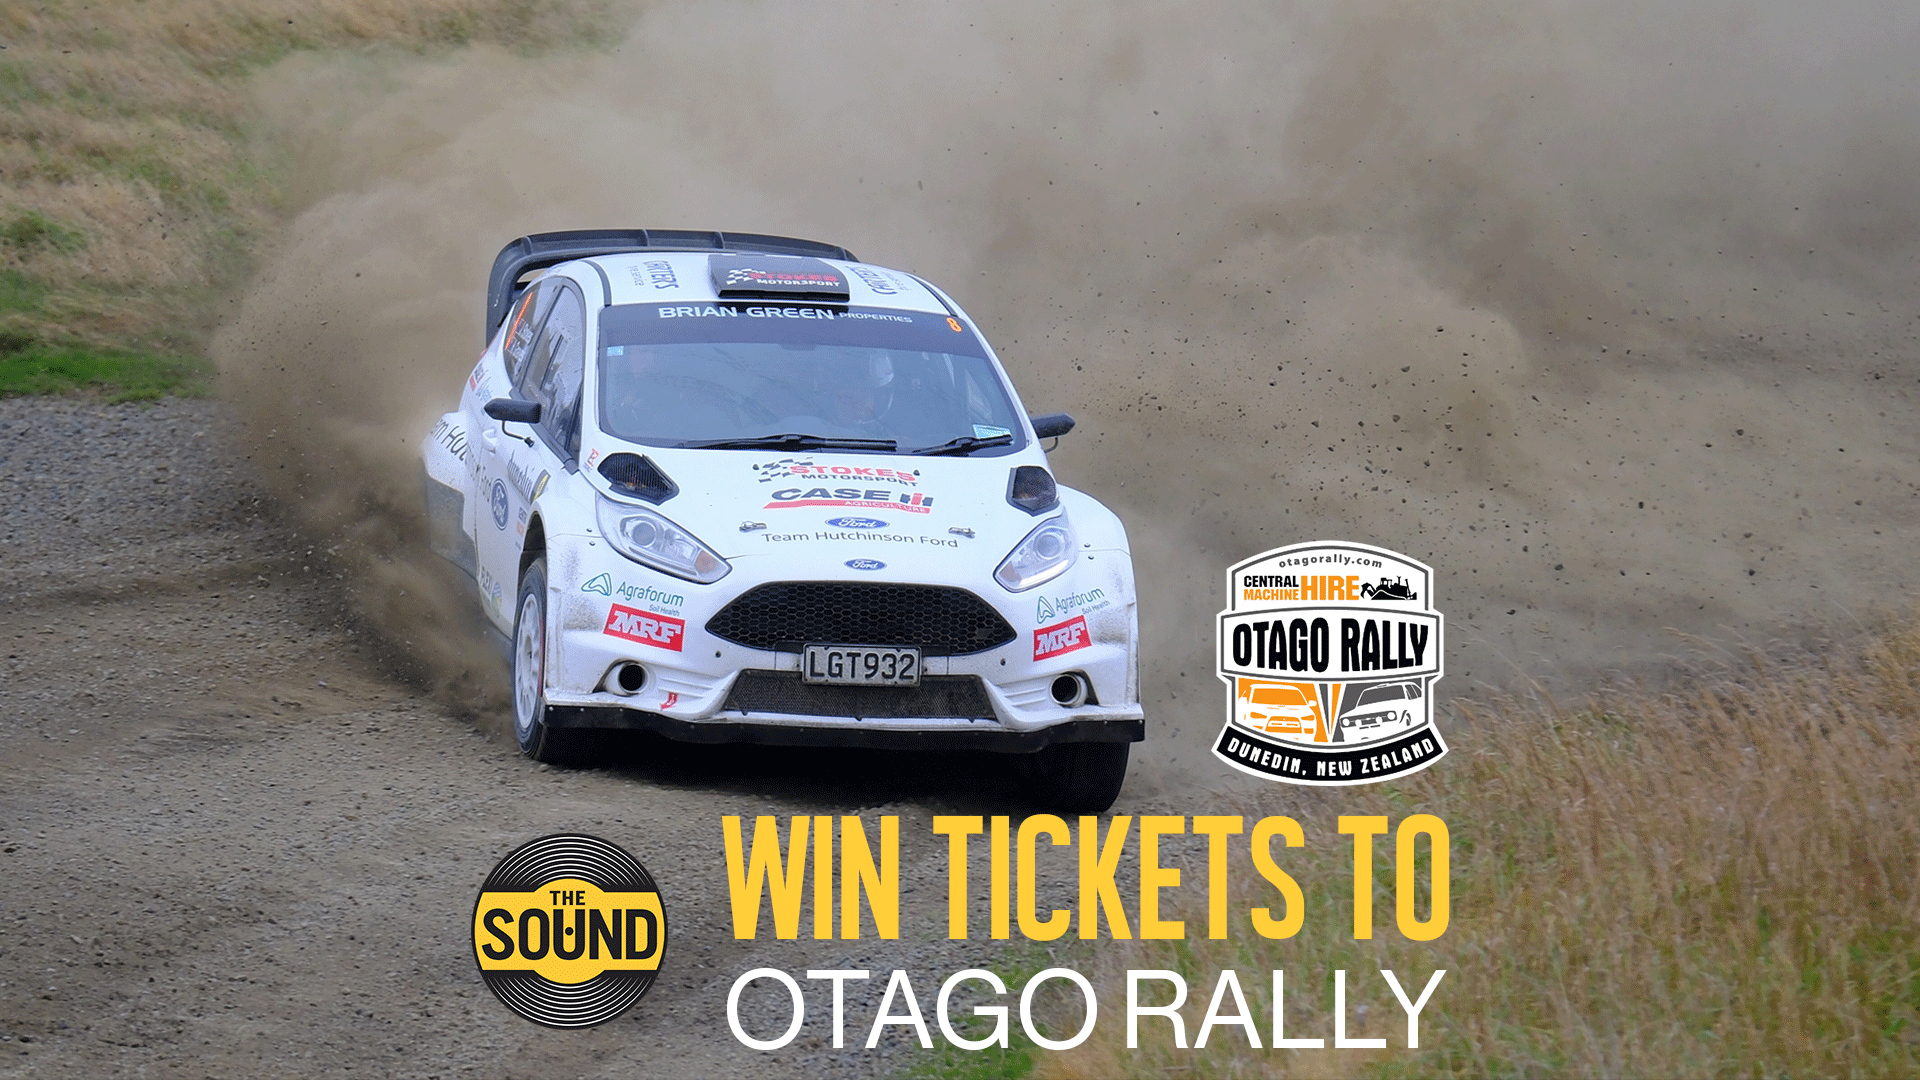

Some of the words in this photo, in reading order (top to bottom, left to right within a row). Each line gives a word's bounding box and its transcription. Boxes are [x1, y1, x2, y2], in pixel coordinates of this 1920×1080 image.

[757, 279, 840, 287] MOTORSPORT
[659, 307, 737, 319] BRIAN
[746, 307, 834, 320] GREEN
[839, 312, 912, 323] PROPERTIES
[947, 317, 962, 333] 8
[790, 465, 916, 482] STOKES
[802, 474, 918, 487] MOTORSPORT
[772, 488, 891, 501] CASE
[844, 501, 927, 513] AGRICULTURE
[761, 533, 809, 543] Team
[816, 531, 914, 544] Hutchinson
[920, 535, 958, 548] Ford
[616, 581, 684, 607] Agraforum
[1055, 588, 1105, 614] Agraforum
[649, 604, 660, 612] Soil
[660, 605, 680, 616] Health
[609, 611, 682, 644] MRF
[1035, 622, 1085, 655] MRF
[810, 651, 915, 680] LGT932
